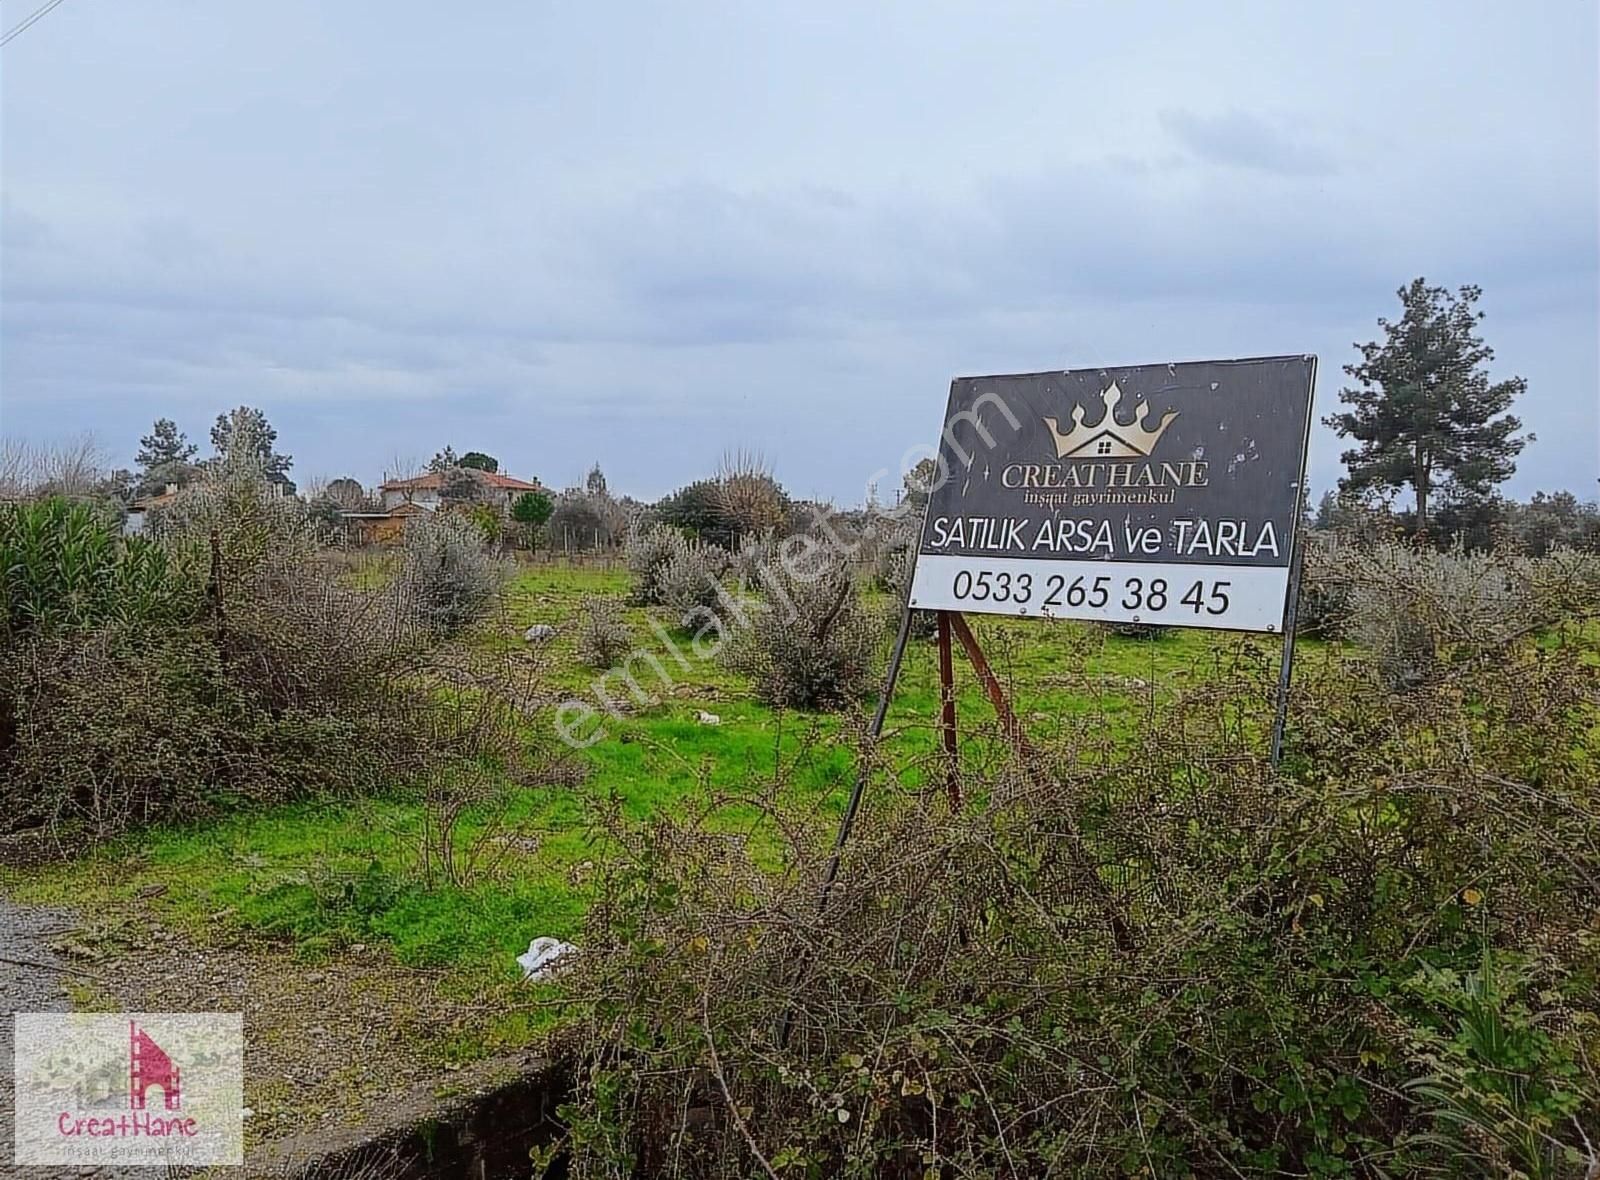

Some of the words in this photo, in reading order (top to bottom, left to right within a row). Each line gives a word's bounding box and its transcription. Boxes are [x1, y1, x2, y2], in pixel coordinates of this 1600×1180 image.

[1072, 488, 1175, 507] gayrimenkul
[930, 517, 1029, 551] SATILIK
[1031, 518, 1115, 553] ARSA
[1123, 527, 1162, 553] ve
[1172, 519, 1280, 558] TARLA
[952, 570, 1033, 604] 0533
[1043, 574, 1111, 608] 265
[1121, 577, 1169, 612] 38
[1179, 580, 1232, 615] 45
